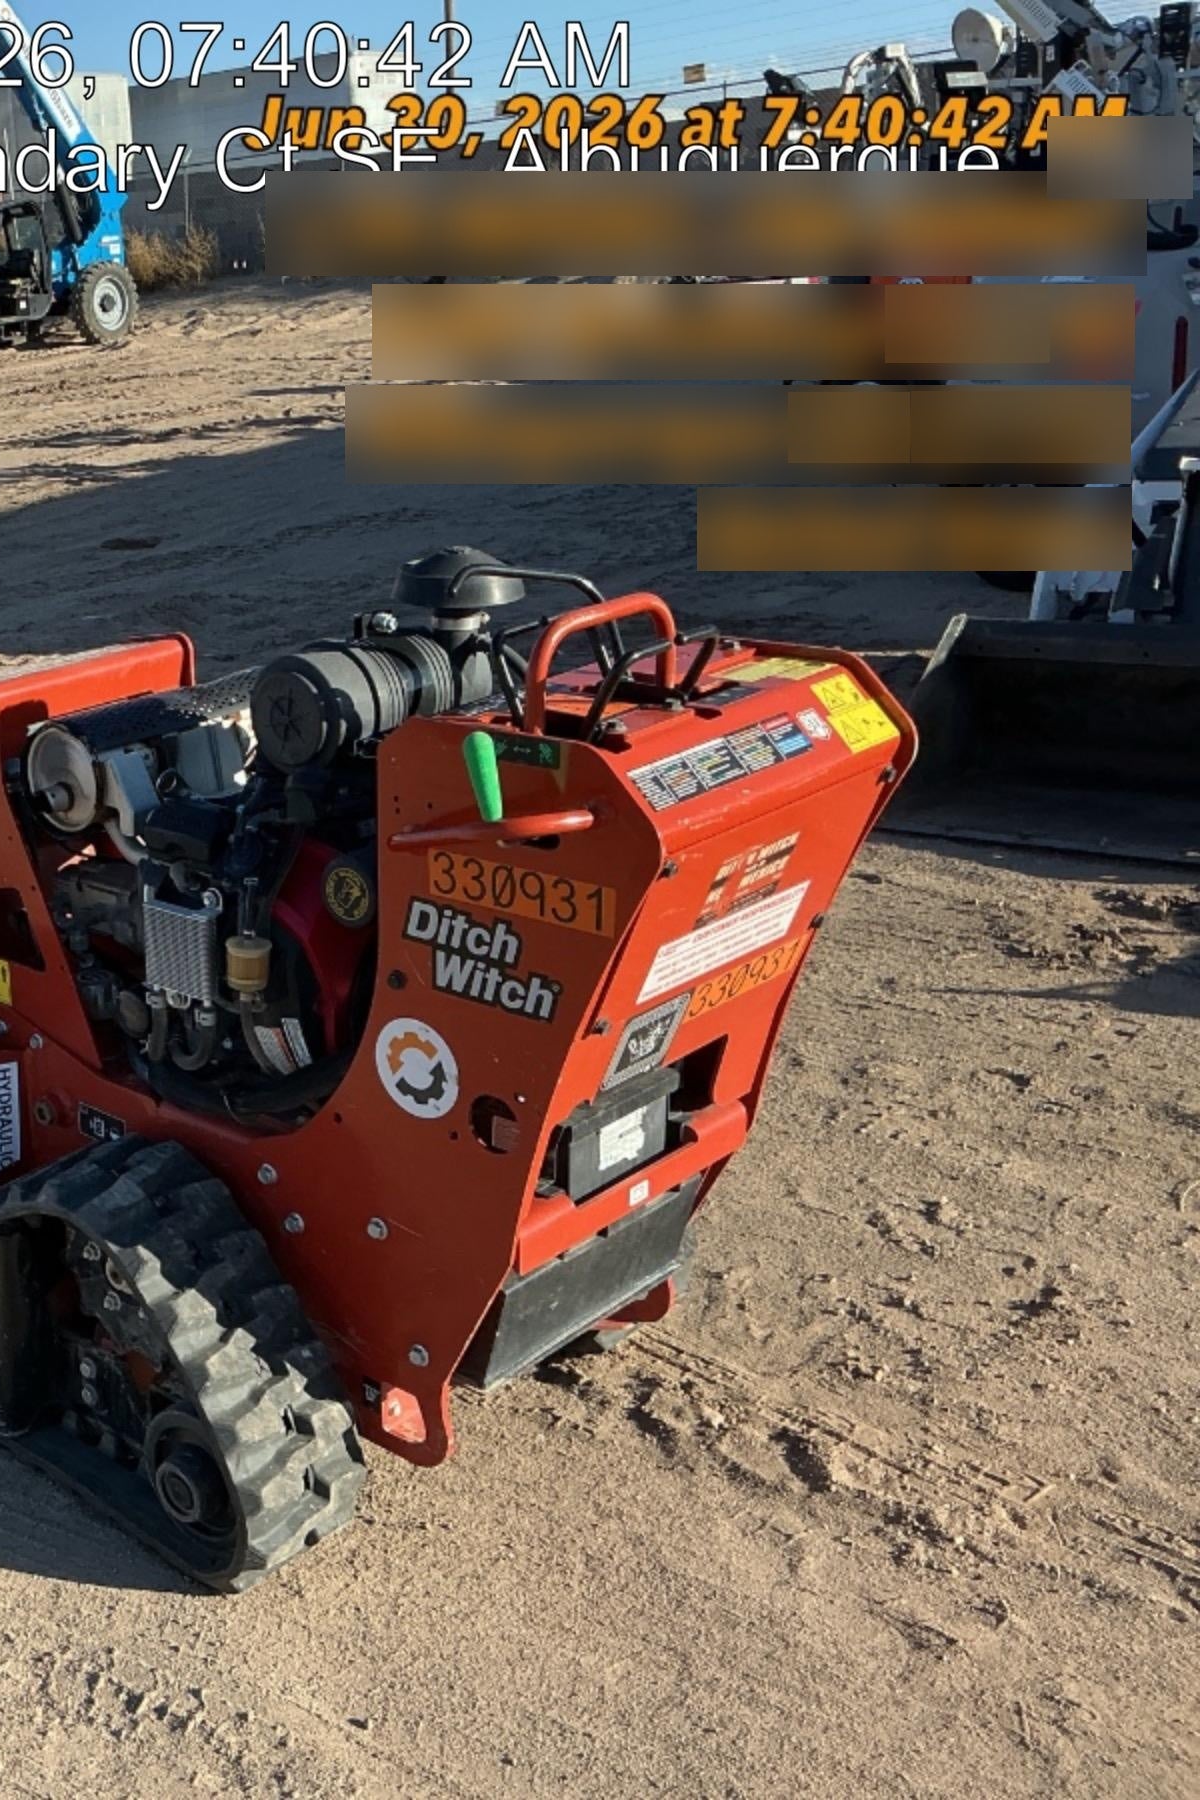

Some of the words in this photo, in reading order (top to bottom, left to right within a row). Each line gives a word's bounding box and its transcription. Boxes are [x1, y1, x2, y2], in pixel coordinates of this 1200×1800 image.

[432, 851, 605, 932] 330931
[406, 900, 520, 963] Ditch
[435, 949, 556, 1019] Witch
[689, 940, 799, 1017] 330931
